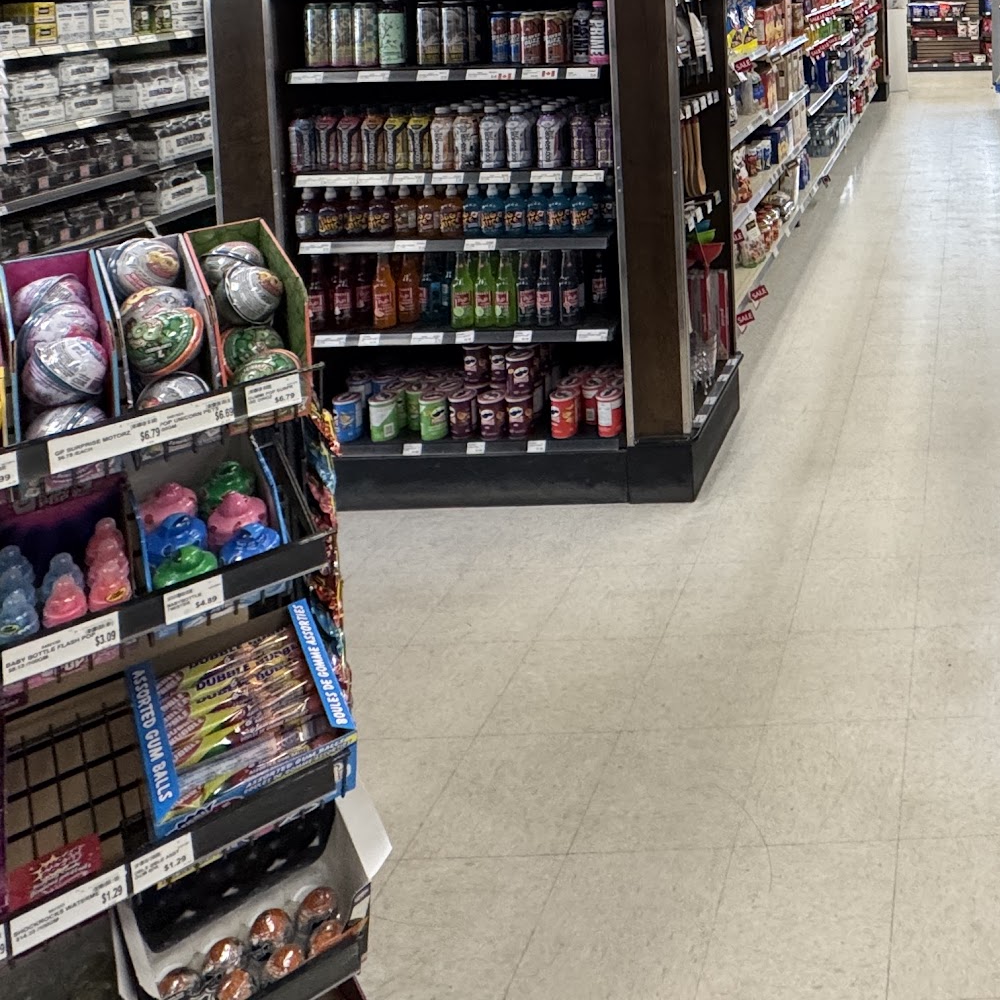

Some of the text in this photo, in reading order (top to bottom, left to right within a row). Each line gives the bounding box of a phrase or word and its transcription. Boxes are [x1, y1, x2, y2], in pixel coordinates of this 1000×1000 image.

[590, 20, 605, 56] PRIME
[752, 288, 767, 299] SALE
[737, 312, 753, 323] SALE
[274, 392, 295, 404] $6.79
[140, 427, 161, 443] $6.79
[195, 596, 218, 609] $4.89
[95, 630, 116, 647] $3.09
[293, 604, 348, 725] BOULES DE GOMME ASSORTIES
[196, 663, 251, 691] DUBBLE
[132, 669, 173, 803] ASSORTED GUM BALLS
[164, 855, 187, 872] $1.29
[102, 885, 123, 905] $1.29
